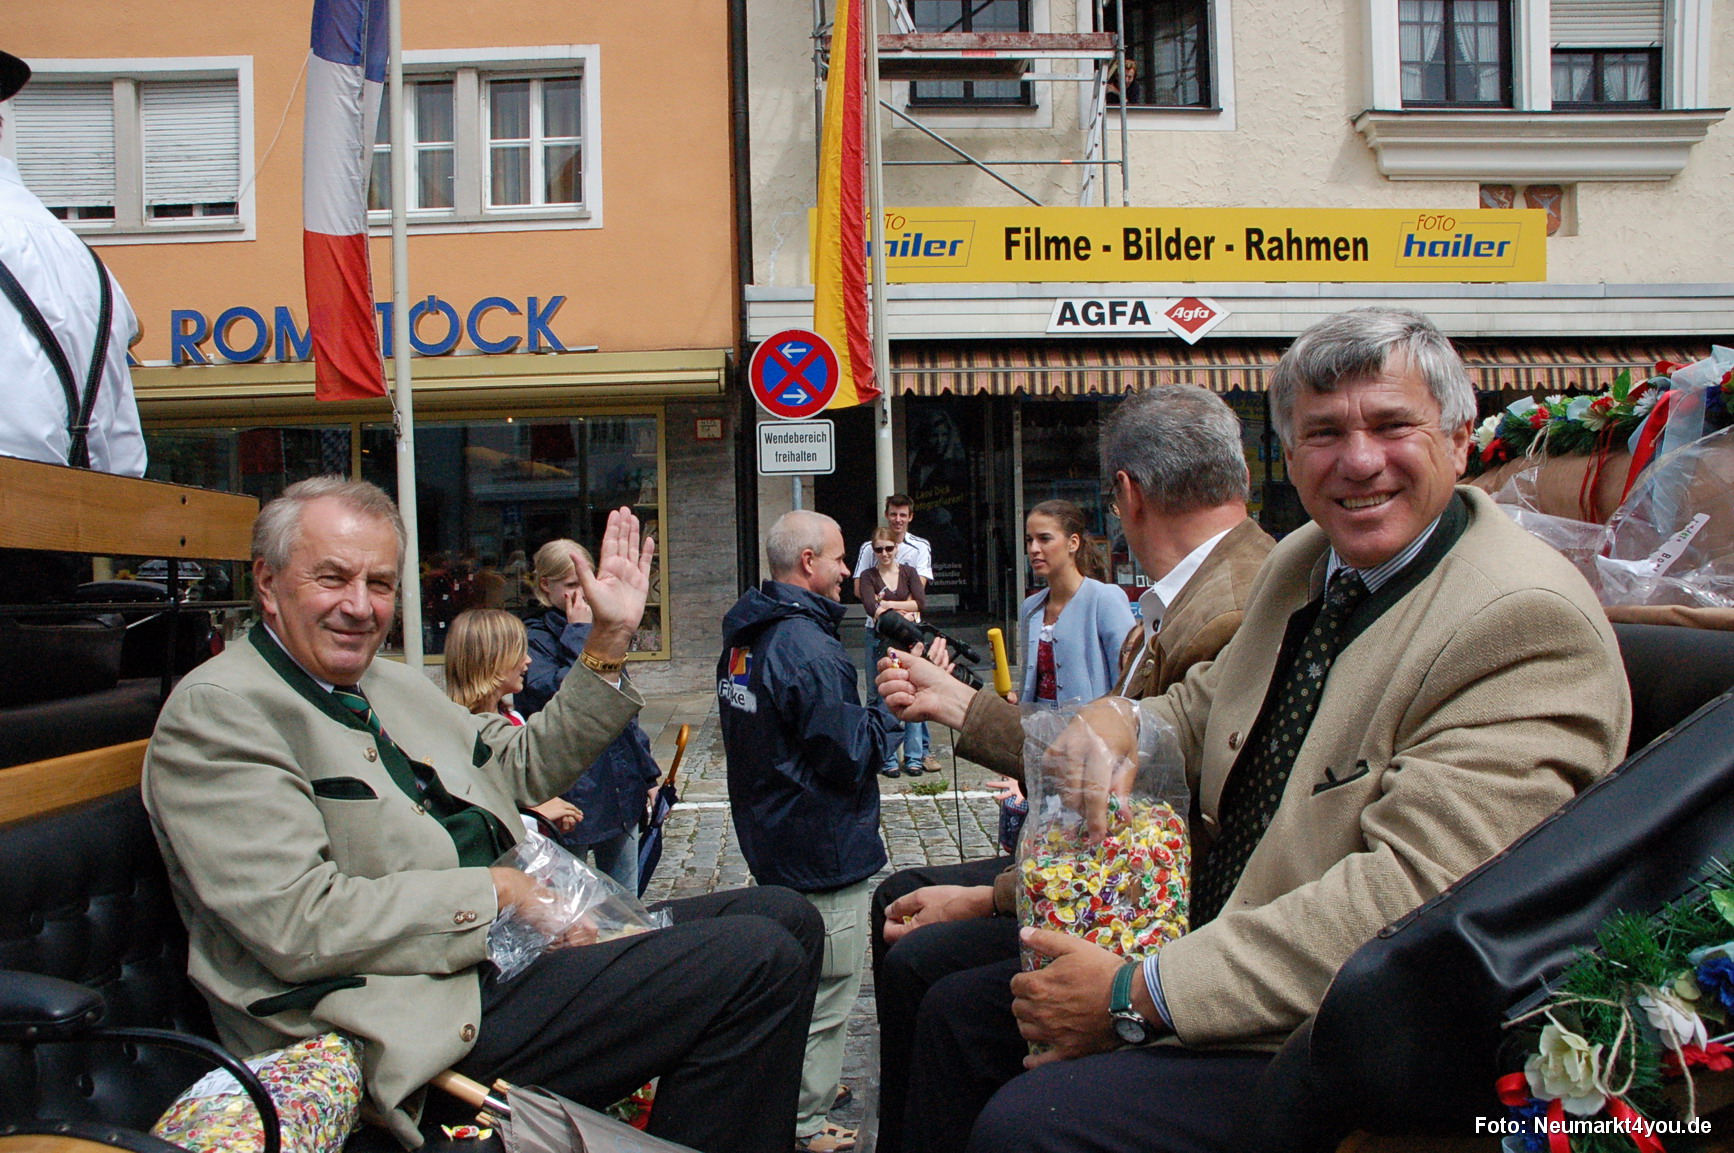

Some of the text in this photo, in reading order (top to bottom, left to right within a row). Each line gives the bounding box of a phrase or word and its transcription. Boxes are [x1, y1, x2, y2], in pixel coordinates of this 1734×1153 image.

[1416, 214, 1456, 231] FOTO
[866, 233, 964, 257] ailer
[1004, 227, 1092, 261] Filme
[1123, 227, 1216, 261] Bilder
[1245, 227, 1369, 262] Rahmen
[1403, 233, 1511, 257] hailer
[1056, 300, 1210, 326] AGFA Agfa
[764, 431, 827, 444] Wendebereich
[775, 450, 818, 463] freihalten
